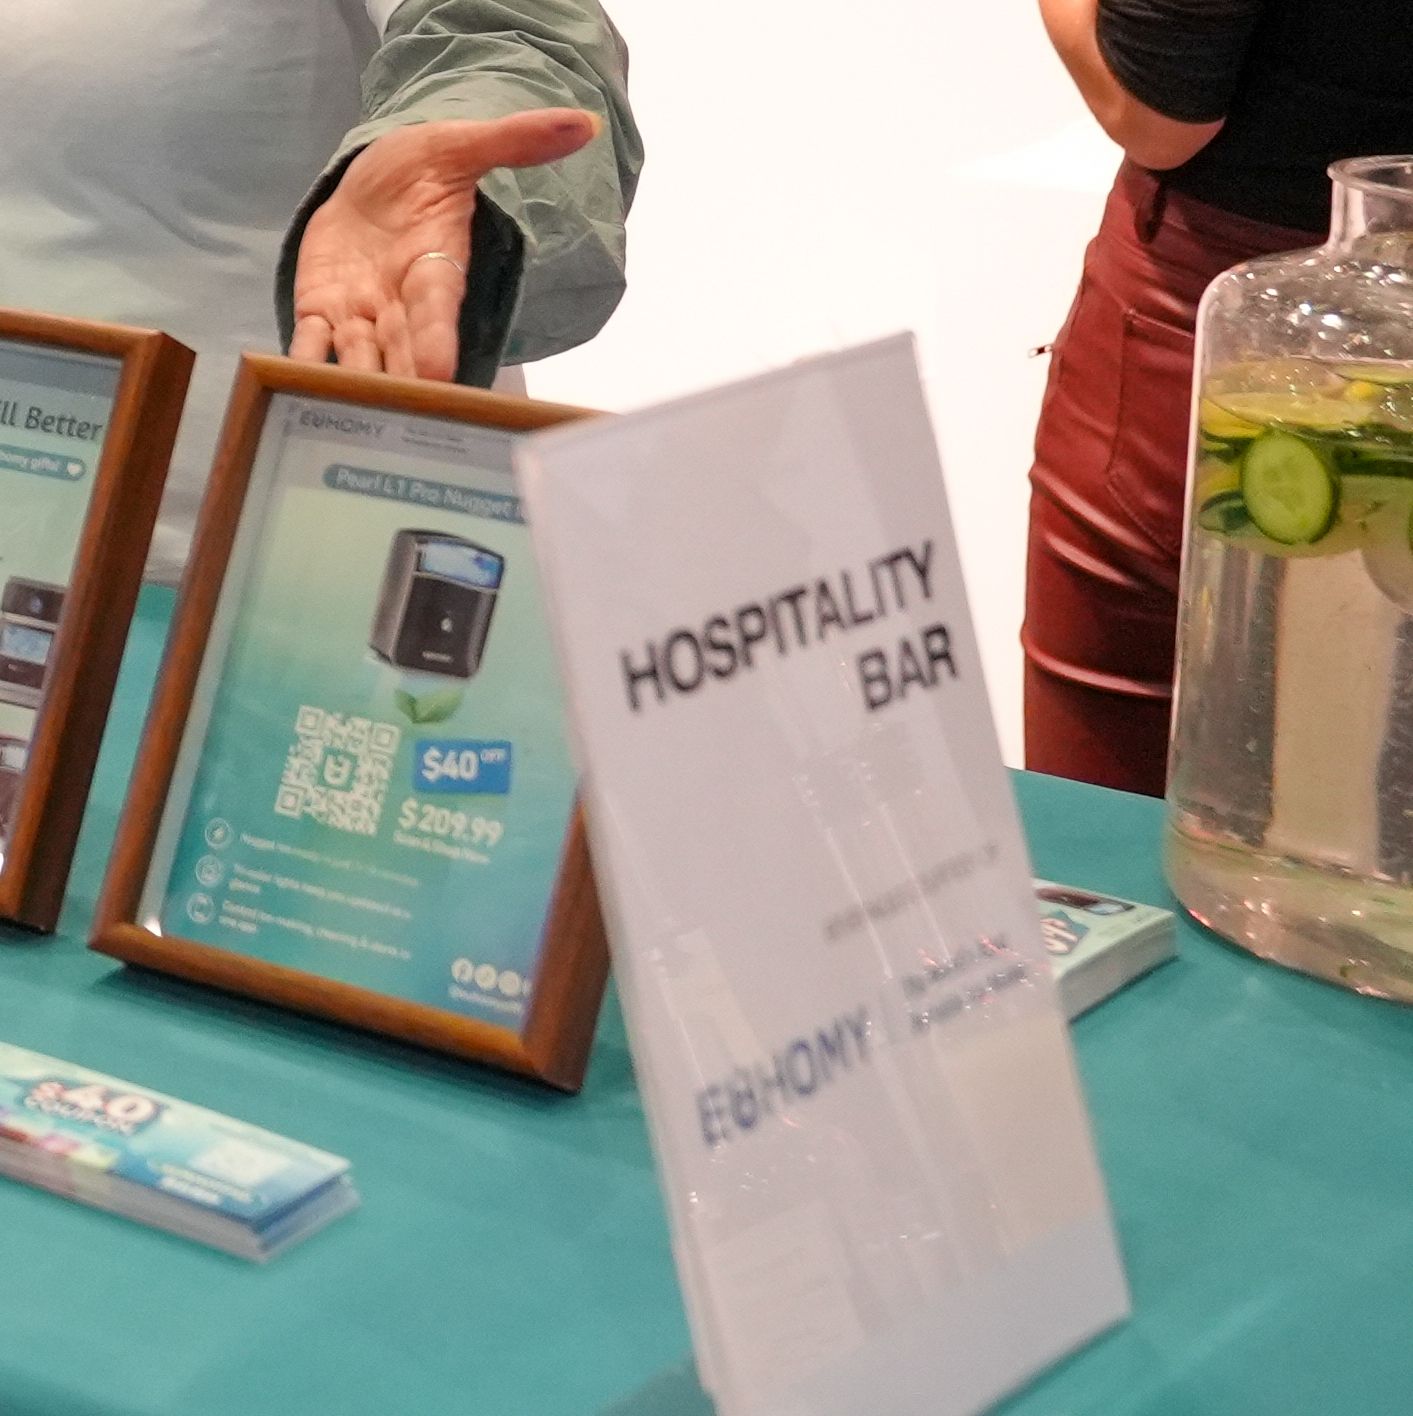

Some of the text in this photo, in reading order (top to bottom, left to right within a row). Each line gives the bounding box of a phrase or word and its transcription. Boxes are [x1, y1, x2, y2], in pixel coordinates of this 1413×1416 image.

[24, 406, 104, 441] Better
[618, 539, 935, 713] HOSPITALITY
[856, 620, 959, 713] BAR
[421, 746, 479, 782] $40
[398, 798, 504, 848] $209.99
